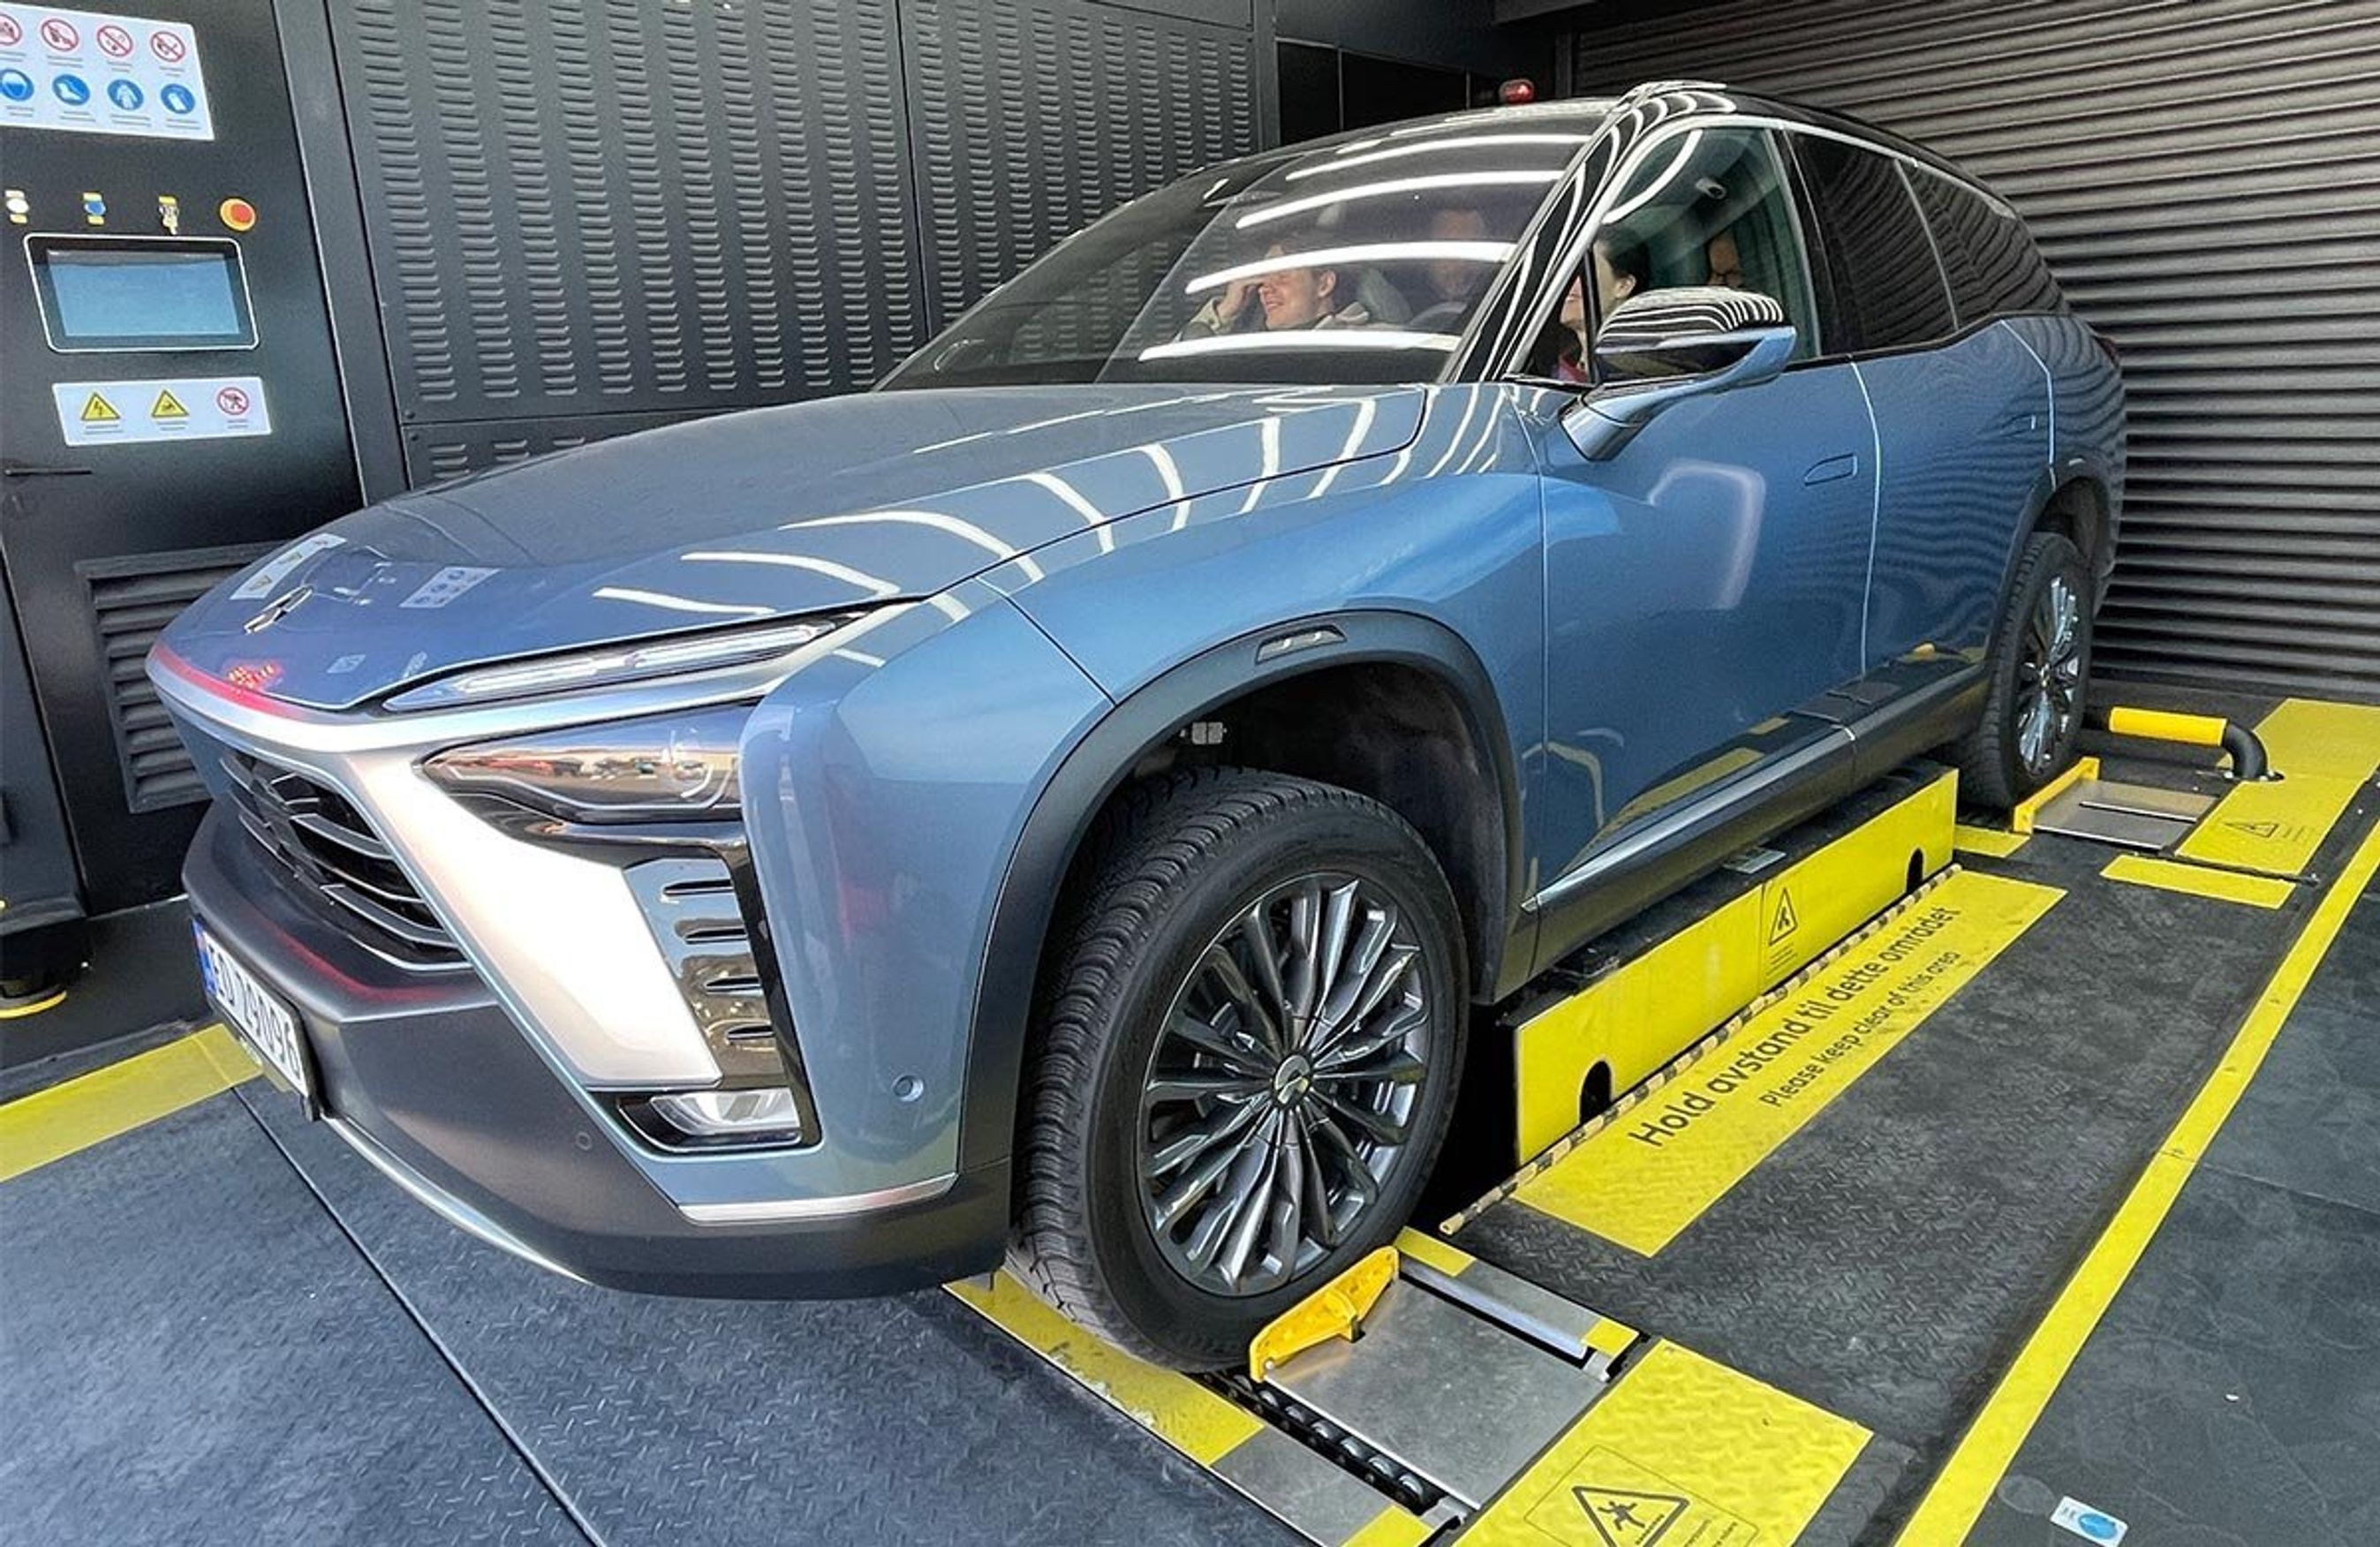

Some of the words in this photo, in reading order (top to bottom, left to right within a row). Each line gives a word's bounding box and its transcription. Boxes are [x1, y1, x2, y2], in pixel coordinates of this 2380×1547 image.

[1628, 1090, 1716, 1146] Hold
[1706, 1017, 1812, 1094] avstand
[1794, 1000, 1840, 1020] til
[1825, 962, 1889, 1001] dette
[1758, 1064, 1825, 1107] Please
[1810, 1033, 1863, 1064] keep
[1854, 1005, 1891, 1035] clear
[1887, 990, 1908, 1006] of
[1898, 972, 1933, 993] this
[1926, 951, 1961, 974] area
